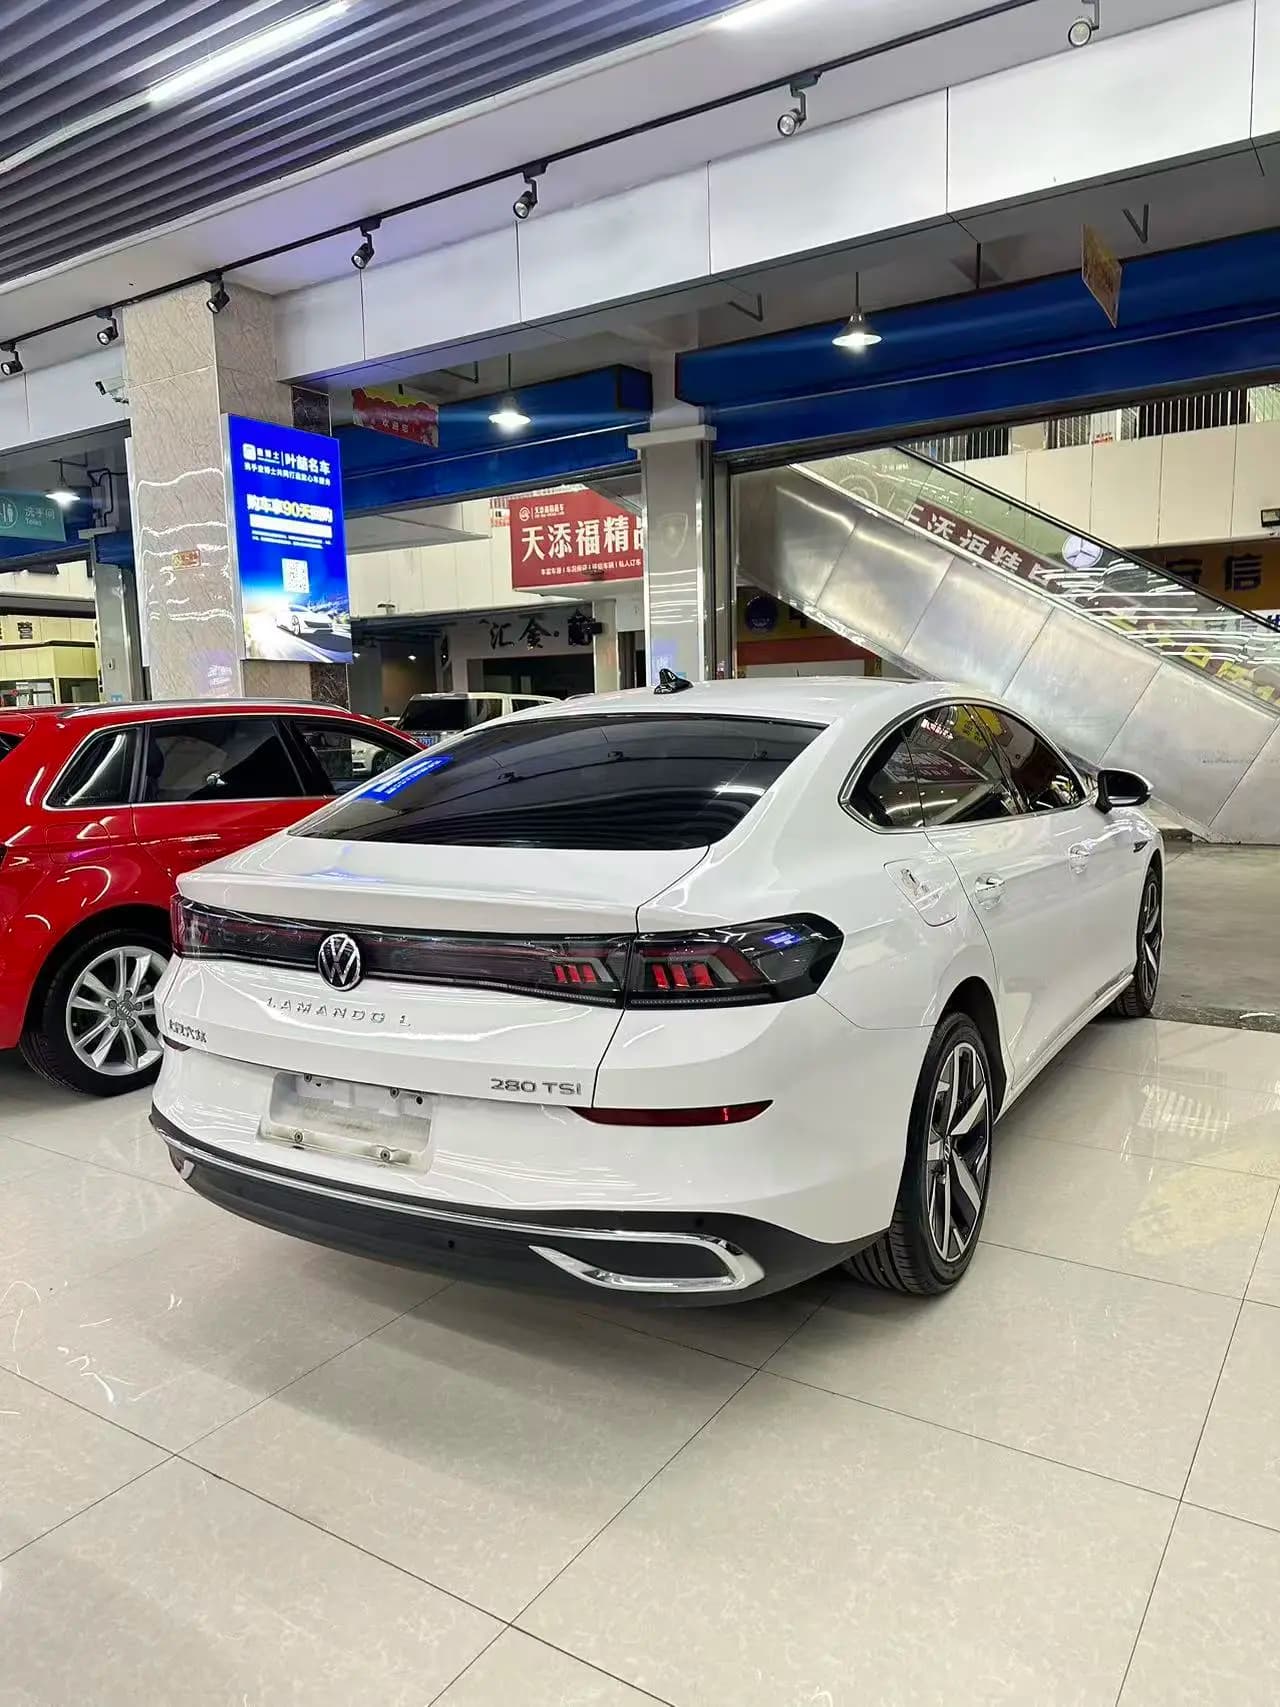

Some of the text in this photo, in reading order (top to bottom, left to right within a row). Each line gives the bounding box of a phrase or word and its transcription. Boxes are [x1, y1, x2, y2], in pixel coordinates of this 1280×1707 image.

[266, 997, 386, 1024] LAMANDO
[490, 1078, 582, 1096] 280 TSI
